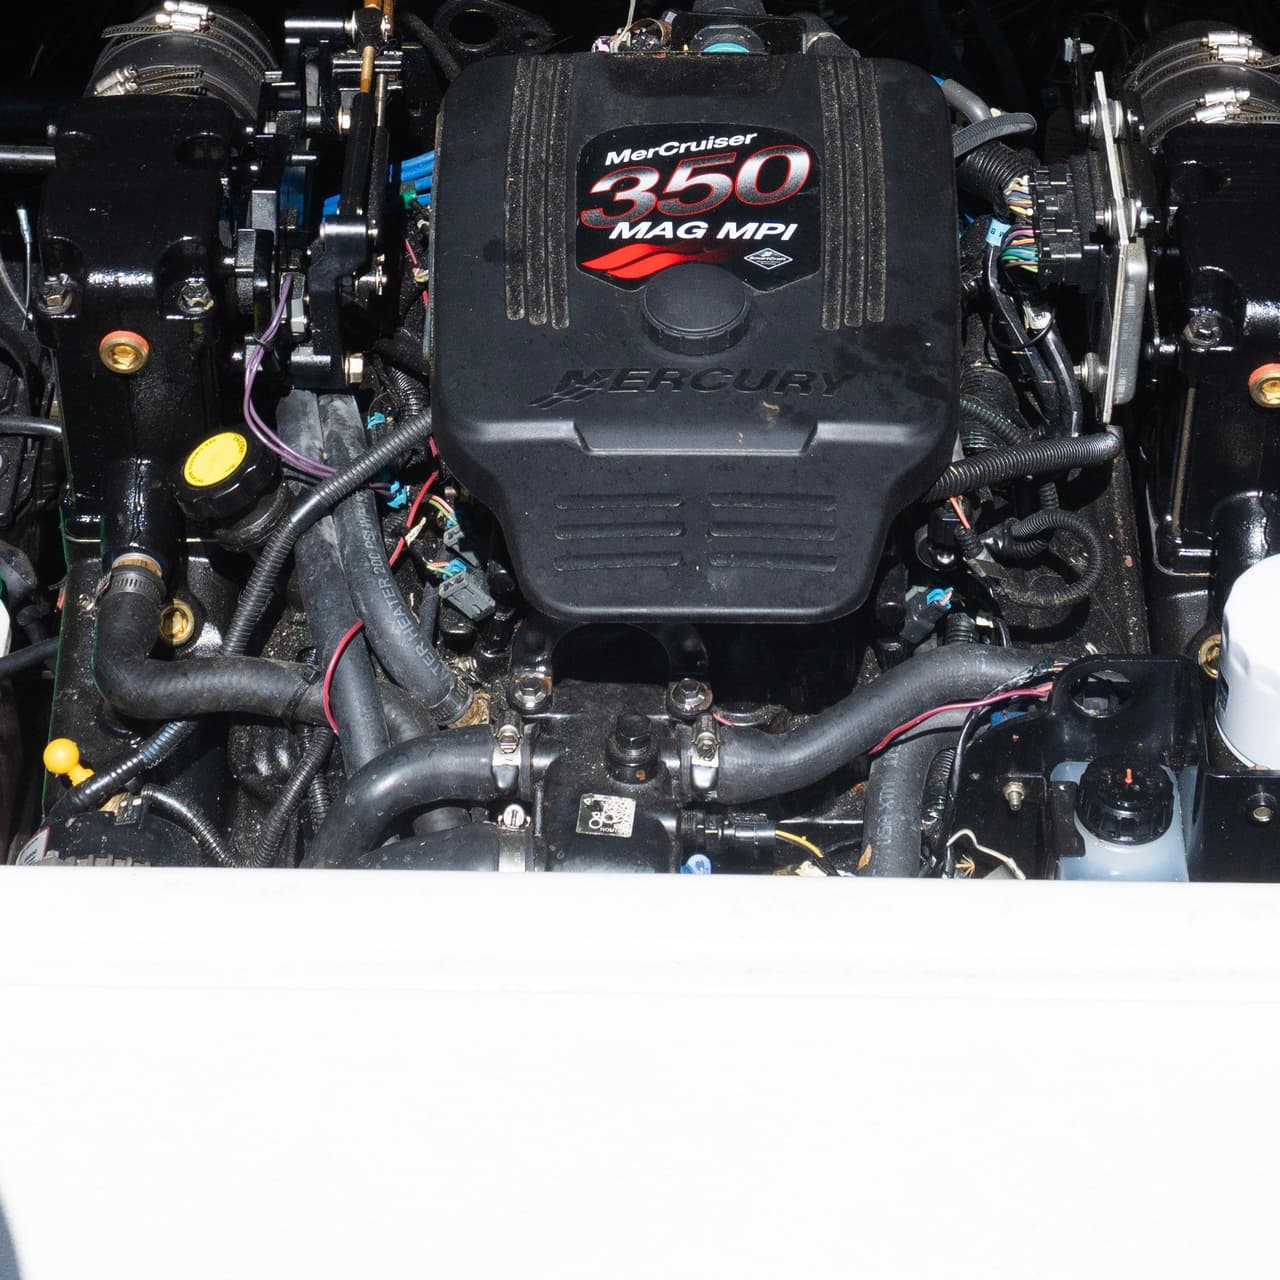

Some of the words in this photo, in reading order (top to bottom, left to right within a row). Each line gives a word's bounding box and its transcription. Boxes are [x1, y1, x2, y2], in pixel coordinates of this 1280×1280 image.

[604, 132, 758, 166] MerCruiser
[579, 144, 812, 229] 350
[608, 220, 710, 241] MAG
[715, 222, 799, 242] MPI
[537, 366, 858, 400] MERCURY
[367, 552, 386, 575] 200
[378, 577, 418, 641] HEATER
